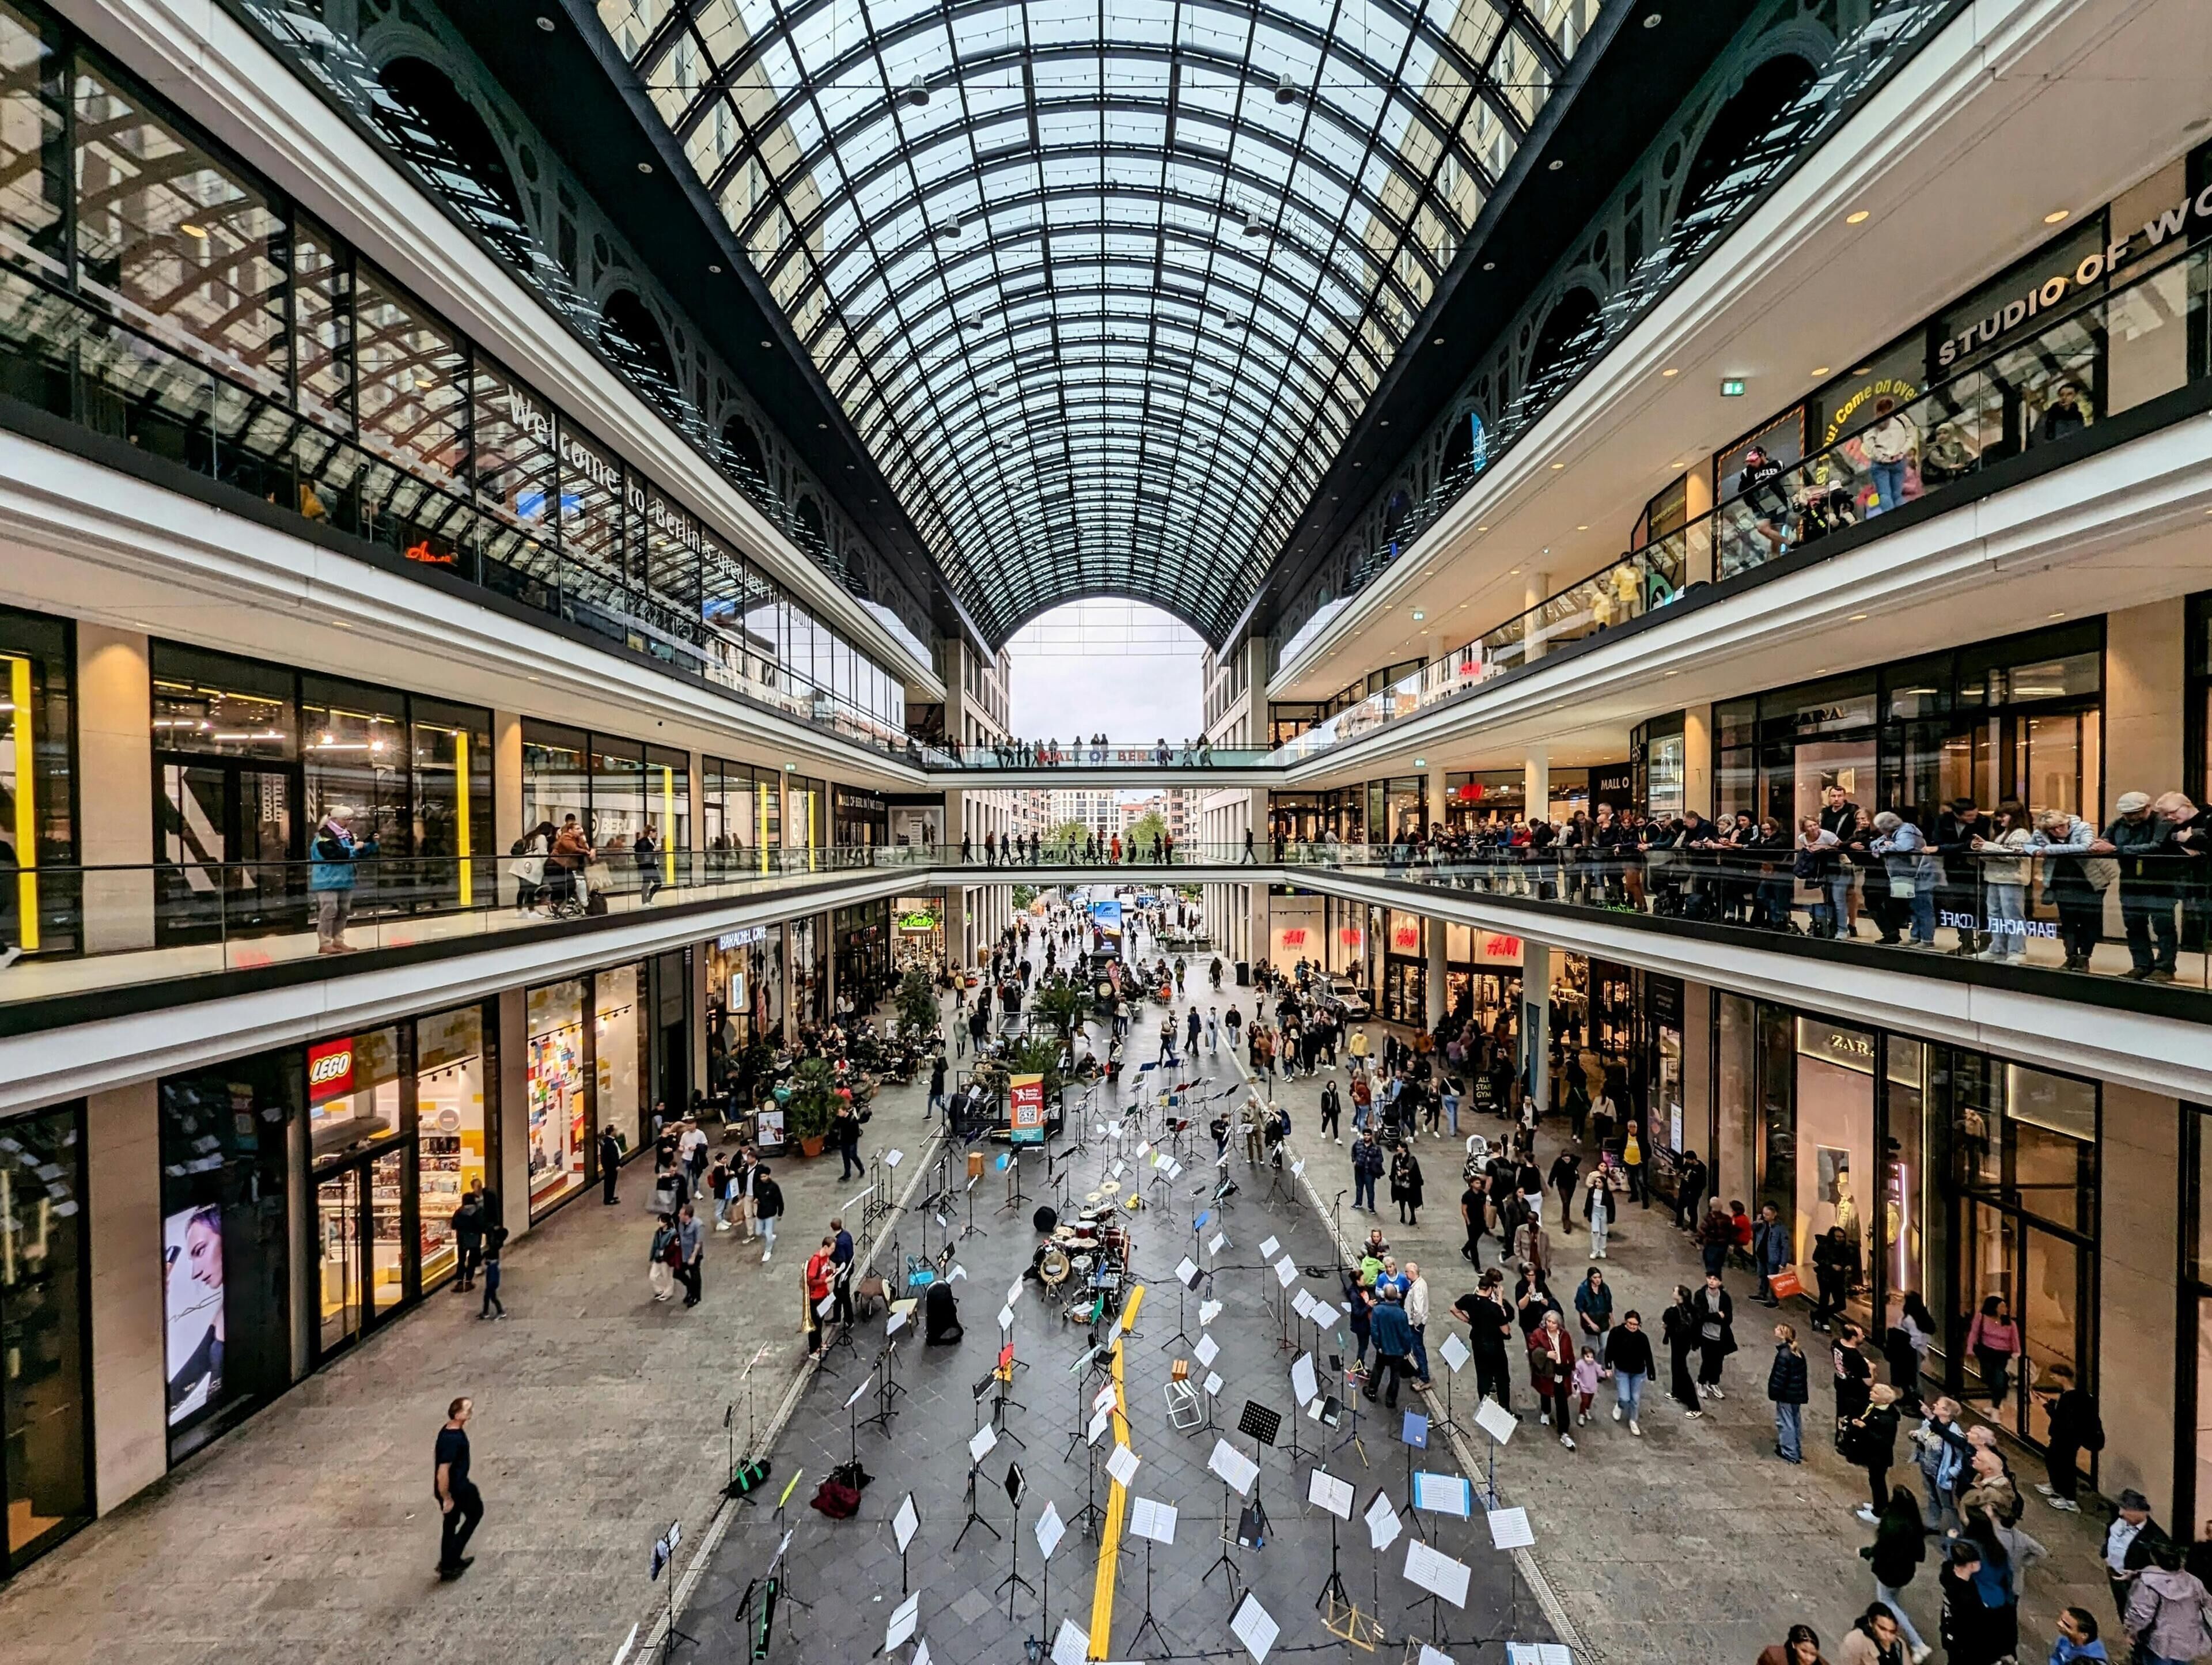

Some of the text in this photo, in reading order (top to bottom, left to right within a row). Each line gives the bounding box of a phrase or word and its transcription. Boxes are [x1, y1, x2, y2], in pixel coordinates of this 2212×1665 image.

[1938, 277, 2069, 366] STUDIO
[2075, 235, 2130, 285] OF
[1836, 385, 1872, 424] Come
[1875, 379, 1892, 395] on
[508, 383, 622, 495] Welcome
[628, 476, 645, 513] to
[1089, 750, 1109, 762] OF
[1601, 778, 1620, 791] MALL
[720, 929, 752, 951] BARACHEL
[1486, 936, 1519, 957] H&M
[310, 1053, 350, 1084] LEGO
